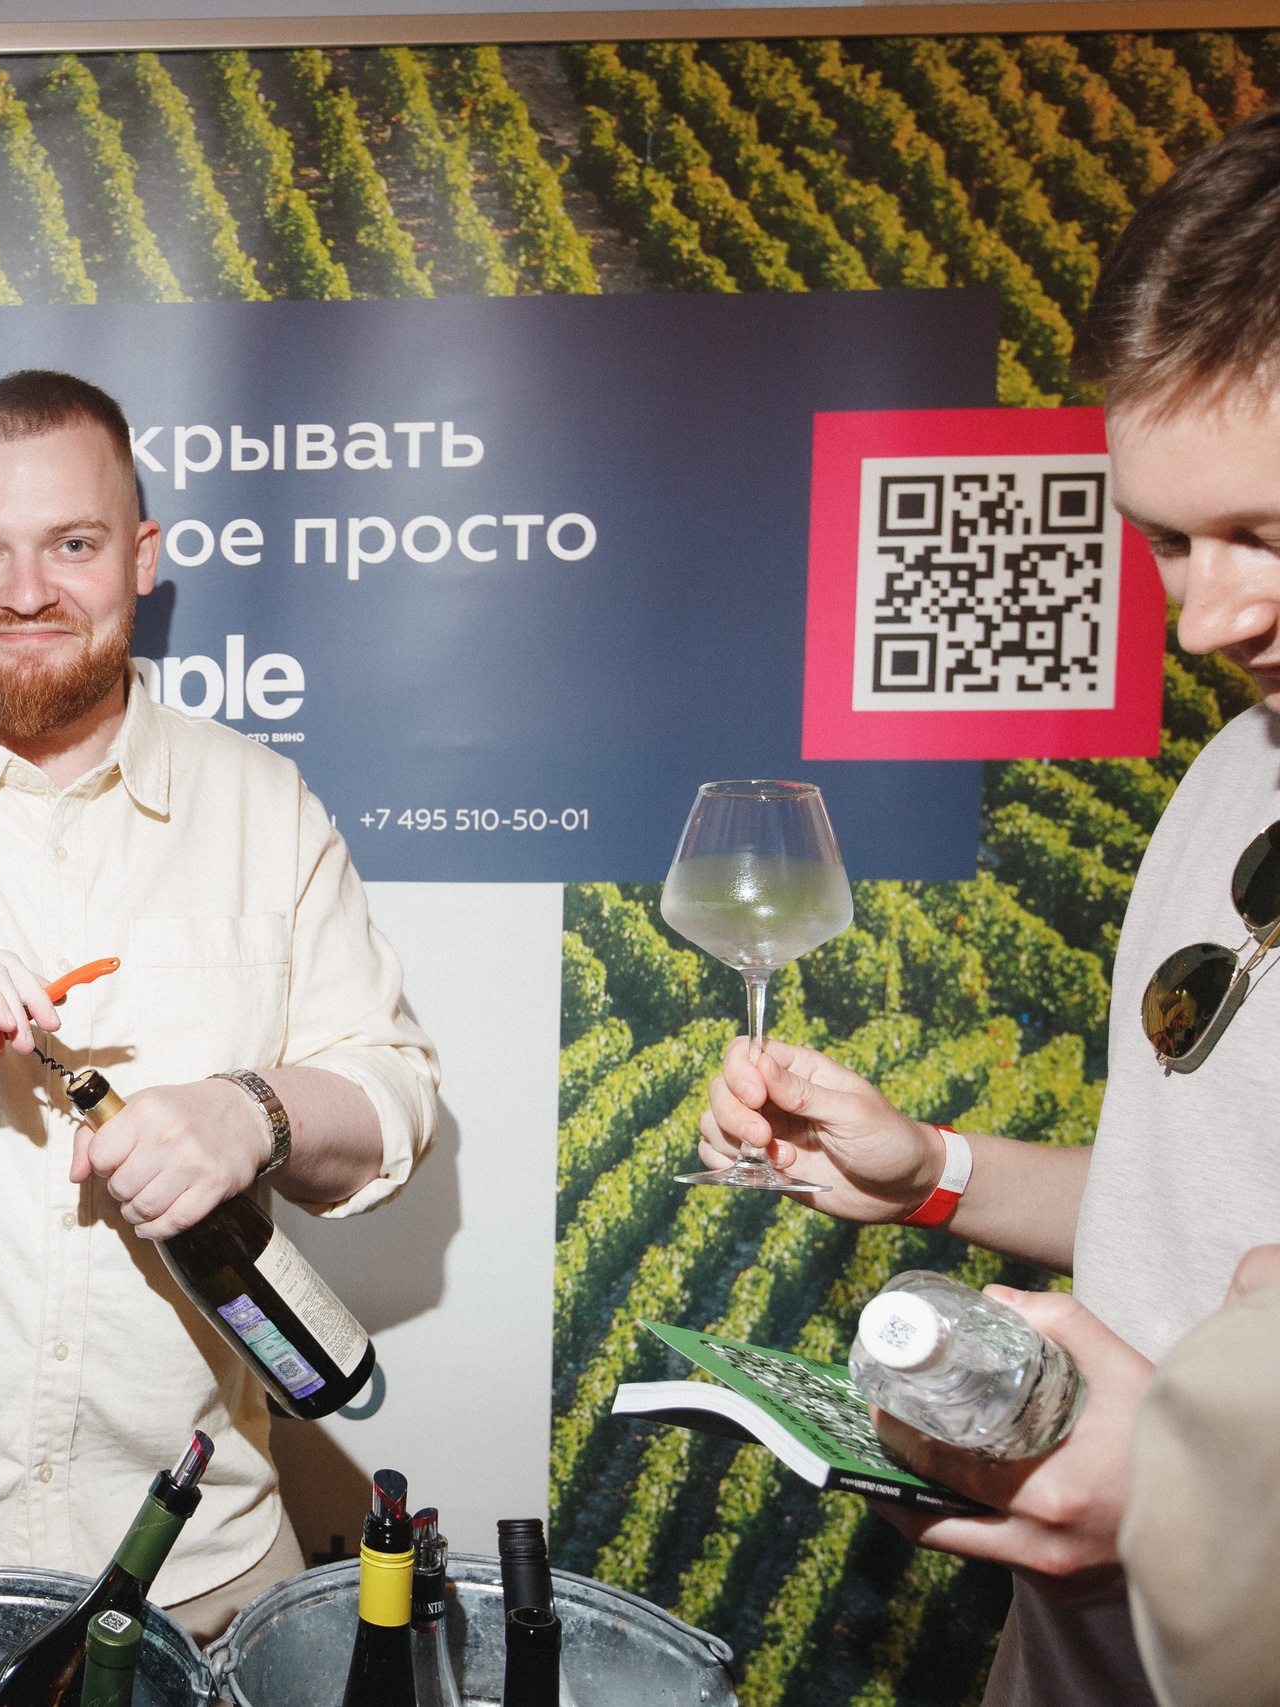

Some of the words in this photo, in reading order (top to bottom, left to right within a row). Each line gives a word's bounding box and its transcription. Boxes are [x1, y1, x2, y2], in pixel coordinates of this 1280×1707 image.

[129, 421, 486, 490] крывать
[294, 512, 598, 581] просто
[131, 634, 306, 720] ple
[360, 808, 391, 831] +7
[397, 808, 448, 831] 495
[454, 808, 589, 831] 510-50-01
